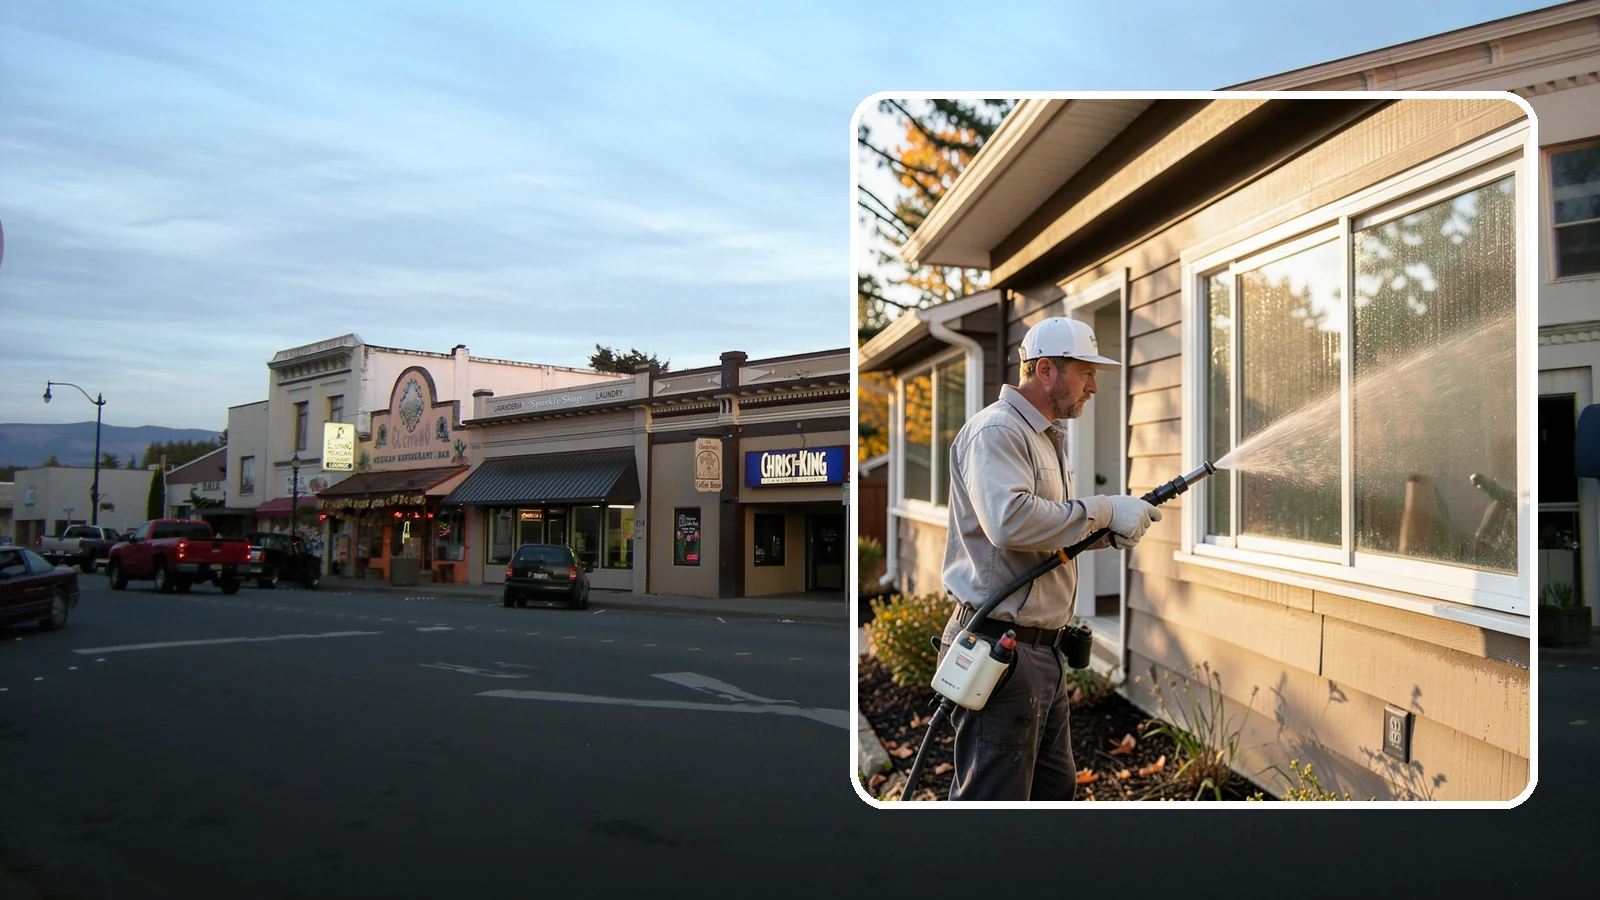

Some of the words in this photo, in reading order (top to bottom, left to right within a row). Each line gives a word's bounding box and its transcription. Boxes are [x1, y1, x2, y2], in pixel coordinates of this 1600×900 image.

[493, 402, 523, 413] LAVANDERIA
[530, 397, 560, 409] Sparkle
[561, 394, 583, 404] Shop
[595, 389, 624, 400] LAUNDRY
[373, 454, 396, 464] MEXICAN
[397, 451, 433, 462] RESTAURANT
[437, 450, 450, 459] BAR
[799, 450, 827, 476] KING
[696, 480, 709, 488] Coffee
[710, 480, 722, 488] House
